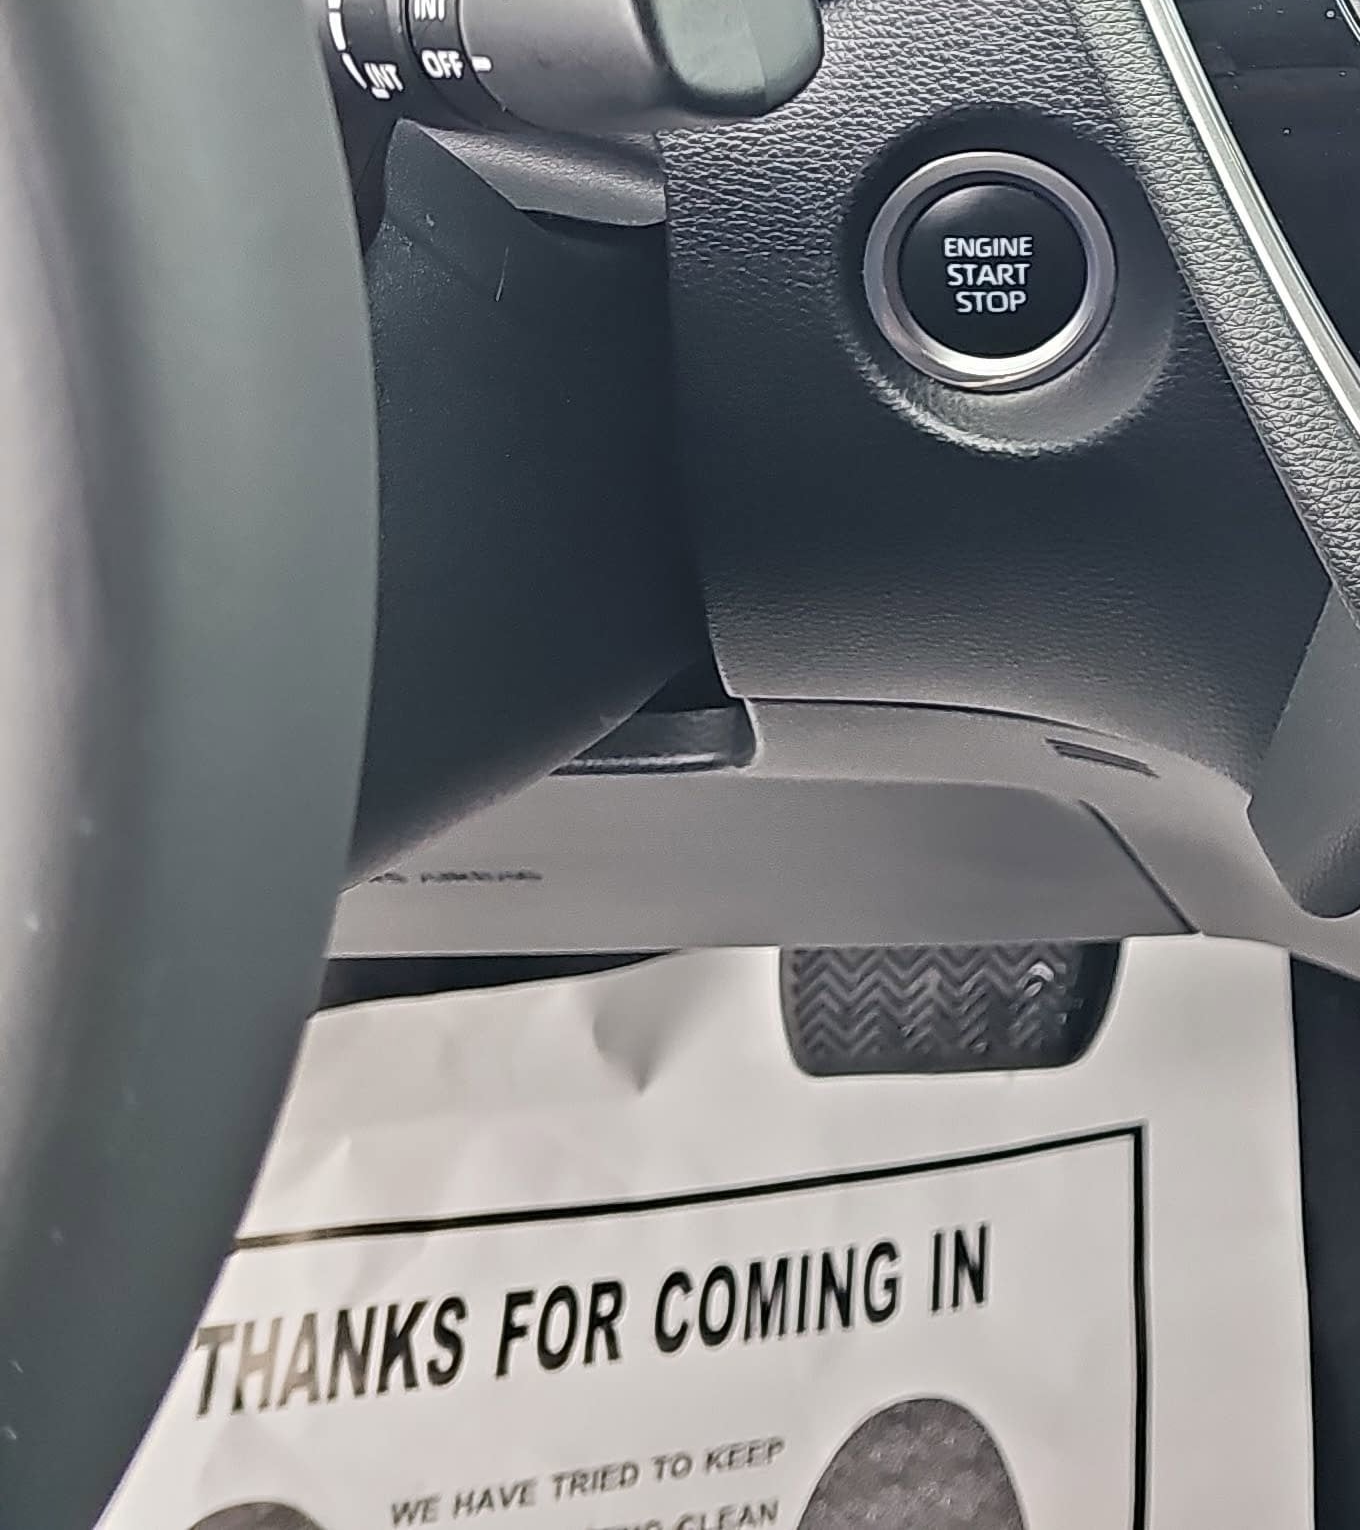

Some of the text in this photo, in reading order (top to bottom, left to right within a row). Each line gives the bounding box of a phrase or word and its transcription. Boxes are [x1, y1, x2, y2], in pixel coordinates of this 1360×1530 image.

[363, 62, 404, 91] INT
[421, 50, 463, 79] OFF
[943, 236, 1033, 257] ENGINE
[946, 263, 1031, 286] START
[955, 291, 1027, 313] STOP
[196, 1222, 988, 1418] THANKS FOR COMING IN
[391, 1435, 786, 1529] WE HAVE TRIED TO KEEP
[676, 1499, 780, 1530] CLEAN
